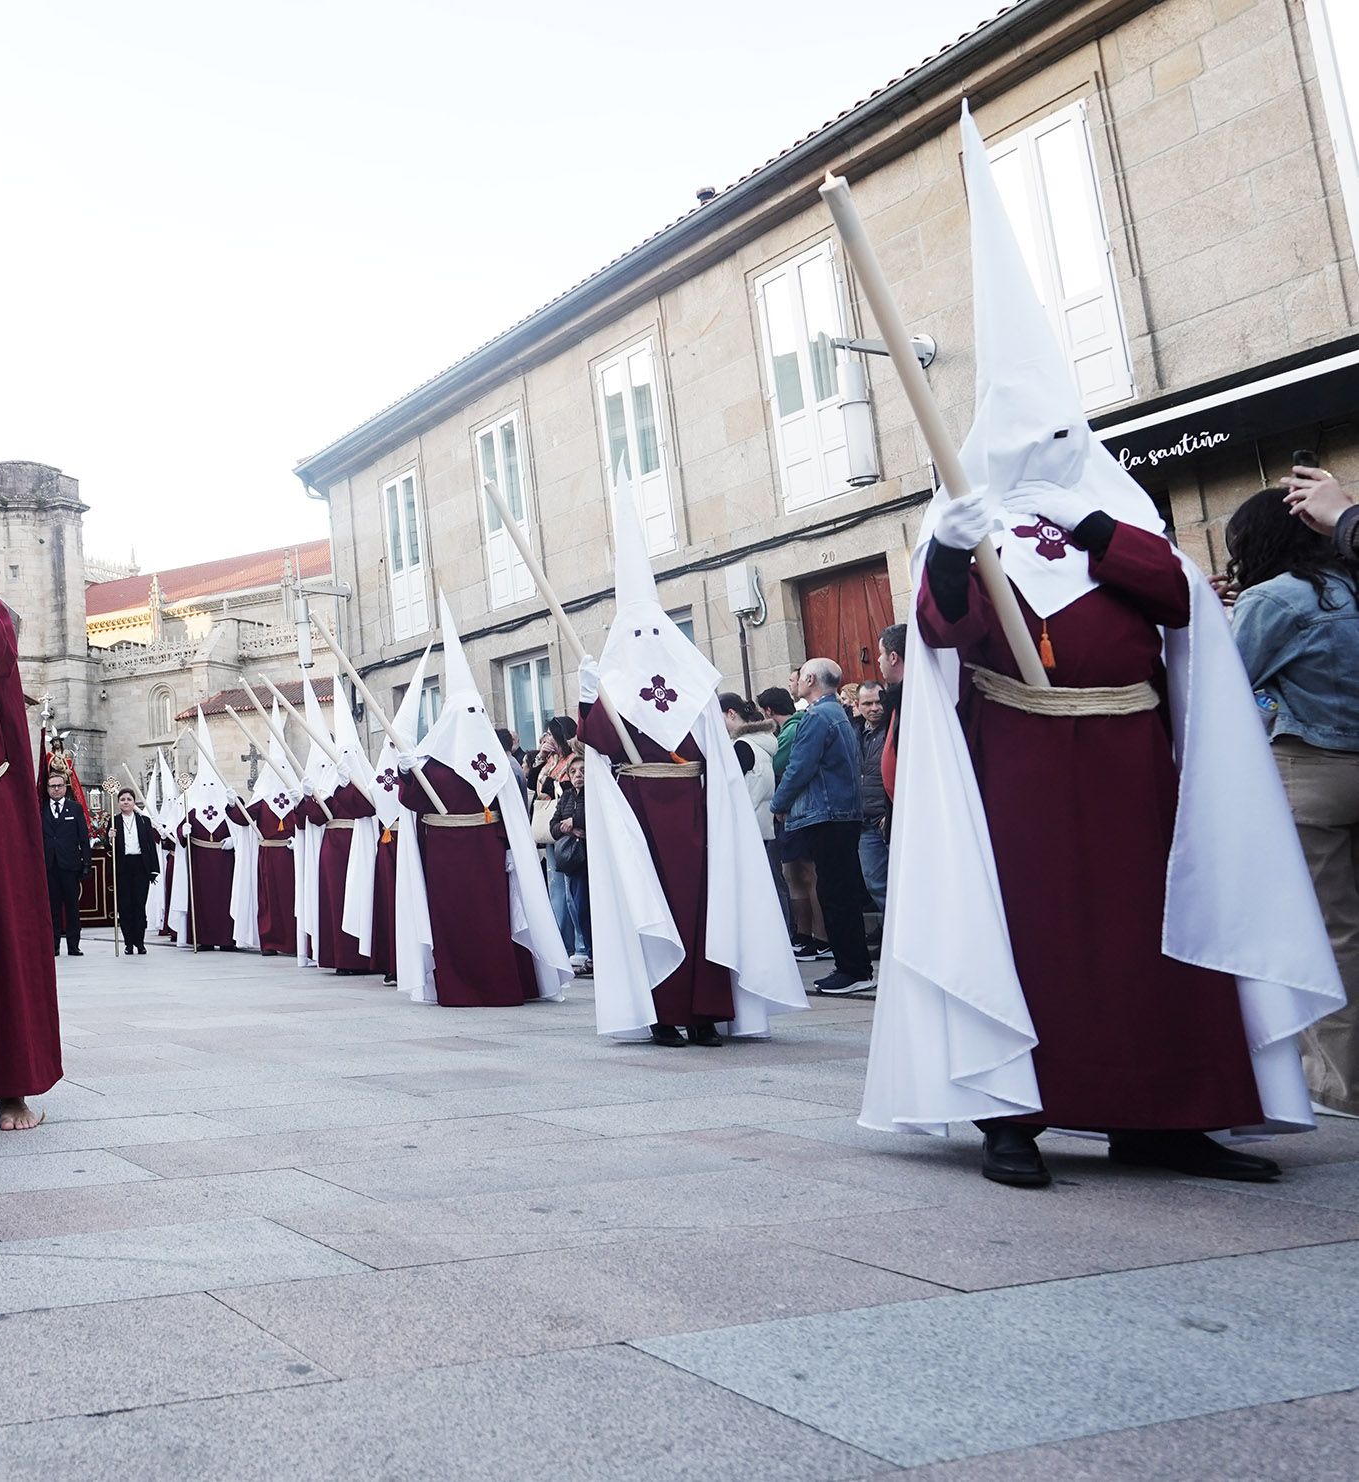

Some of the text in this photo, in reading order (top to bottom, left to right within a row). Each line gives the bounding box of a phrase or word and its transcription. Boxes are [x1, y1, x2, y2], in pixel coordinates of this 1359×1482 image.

[1118, 431, 1230, 471] la santiña
[1046, 528, 1059, 537] IP
[821, 550, 836, 564] 20
